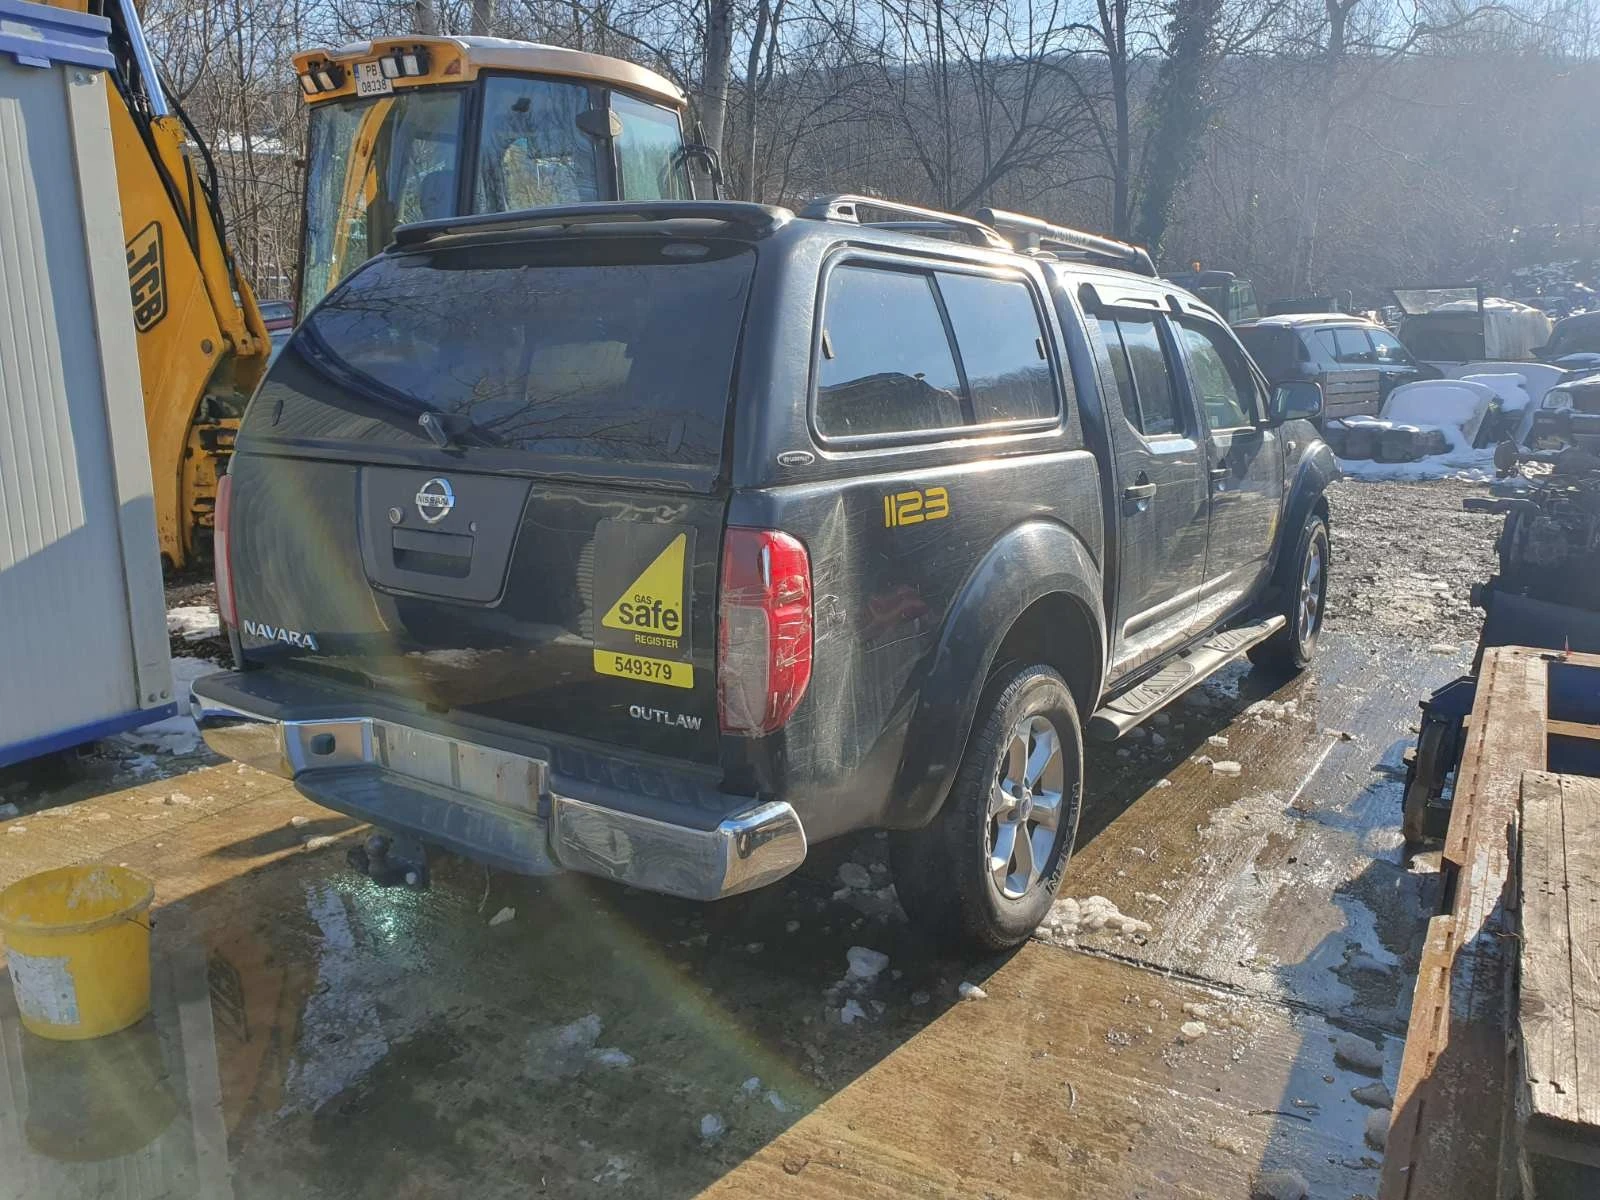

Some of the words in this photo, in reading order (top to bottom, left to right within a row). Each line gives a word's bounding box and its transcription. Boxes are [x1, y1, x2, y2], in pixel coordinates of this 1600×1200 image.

[365, 65, 378, 77] PB
[361, 79, 387, 93] 08338
[126, 240, 162, 325] JCB
[418, 494, 451, 506] NISSAN
[884, 487, 950, 528] 1123
[634, 594, 653, 605] GAS
[618, 600, 680, 632] safe
[243, 619, 319, 652] NAVARA
[634, 633, 679, 649] REGISTER
[614, 656, 673, 681] 549379
[629, 705, 703, 731] OUTLAW
